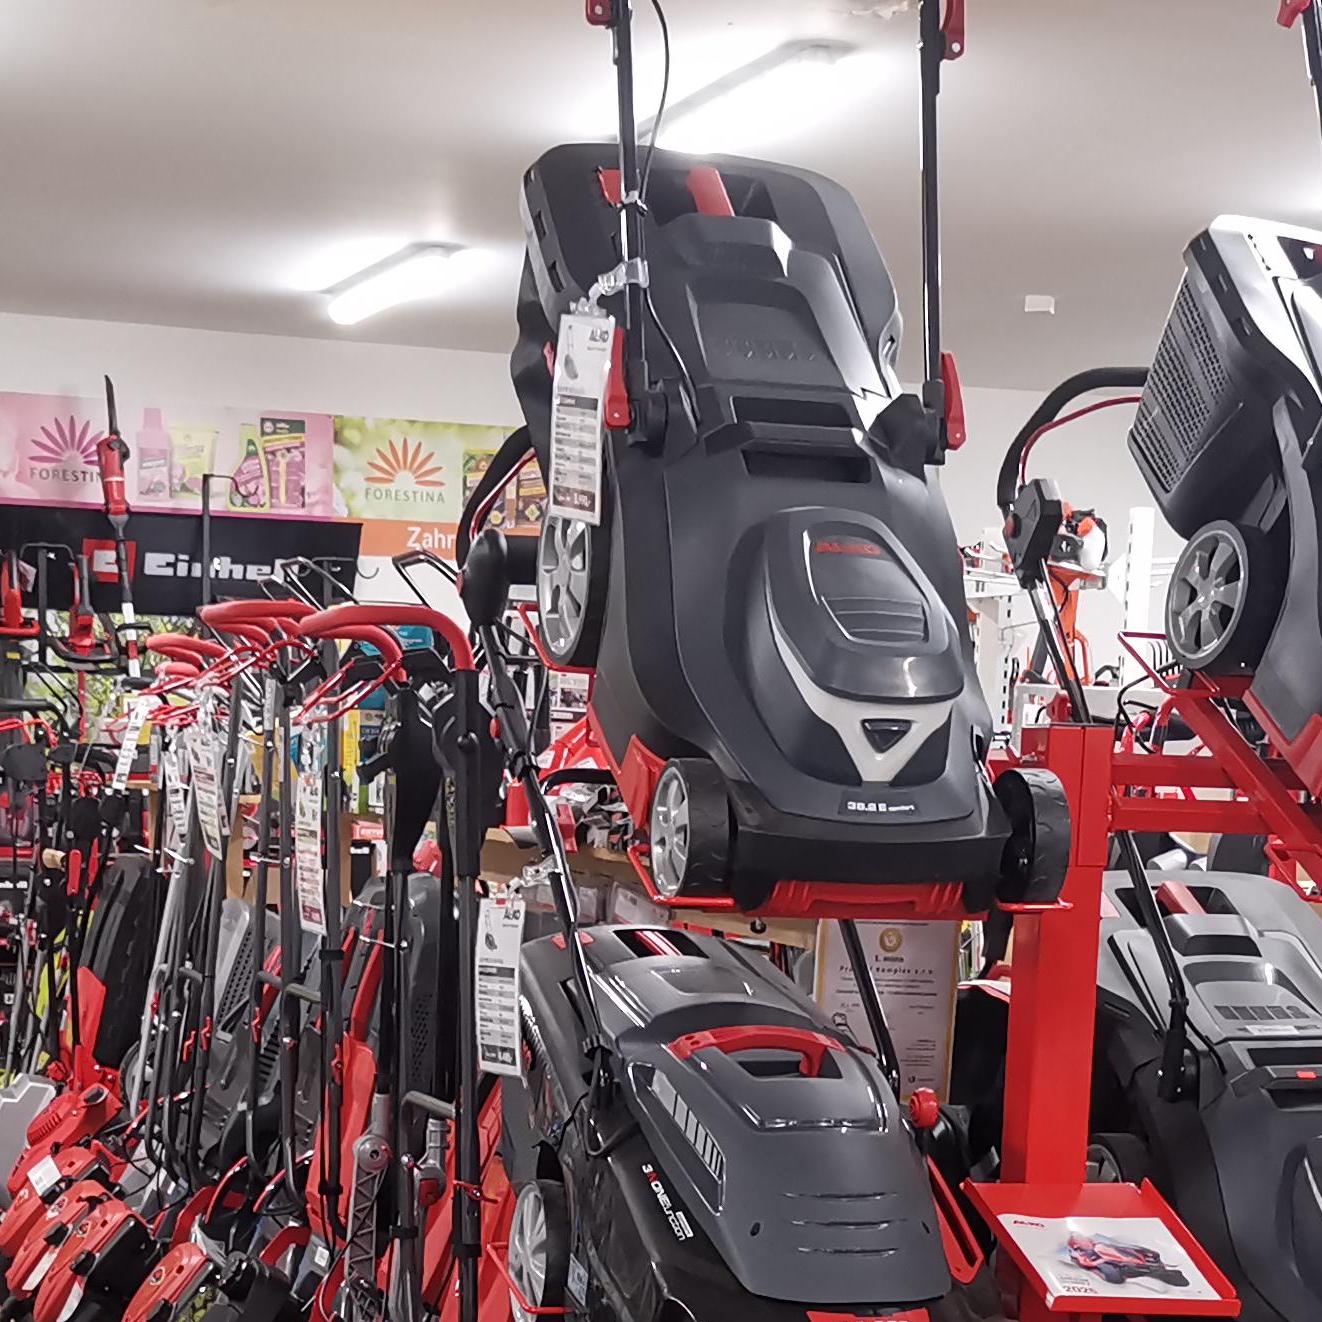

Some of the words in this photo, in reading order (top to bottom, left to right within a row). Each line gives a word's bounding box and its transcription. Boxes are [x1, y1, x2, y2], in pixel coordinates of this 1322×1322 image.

[30, 466, 101, 483] FORESTI
[364, 487, 446, 504] FORESTINA
[407, 526, 456, 550] Zahr
[144, 551, 288, 584] Einhel
